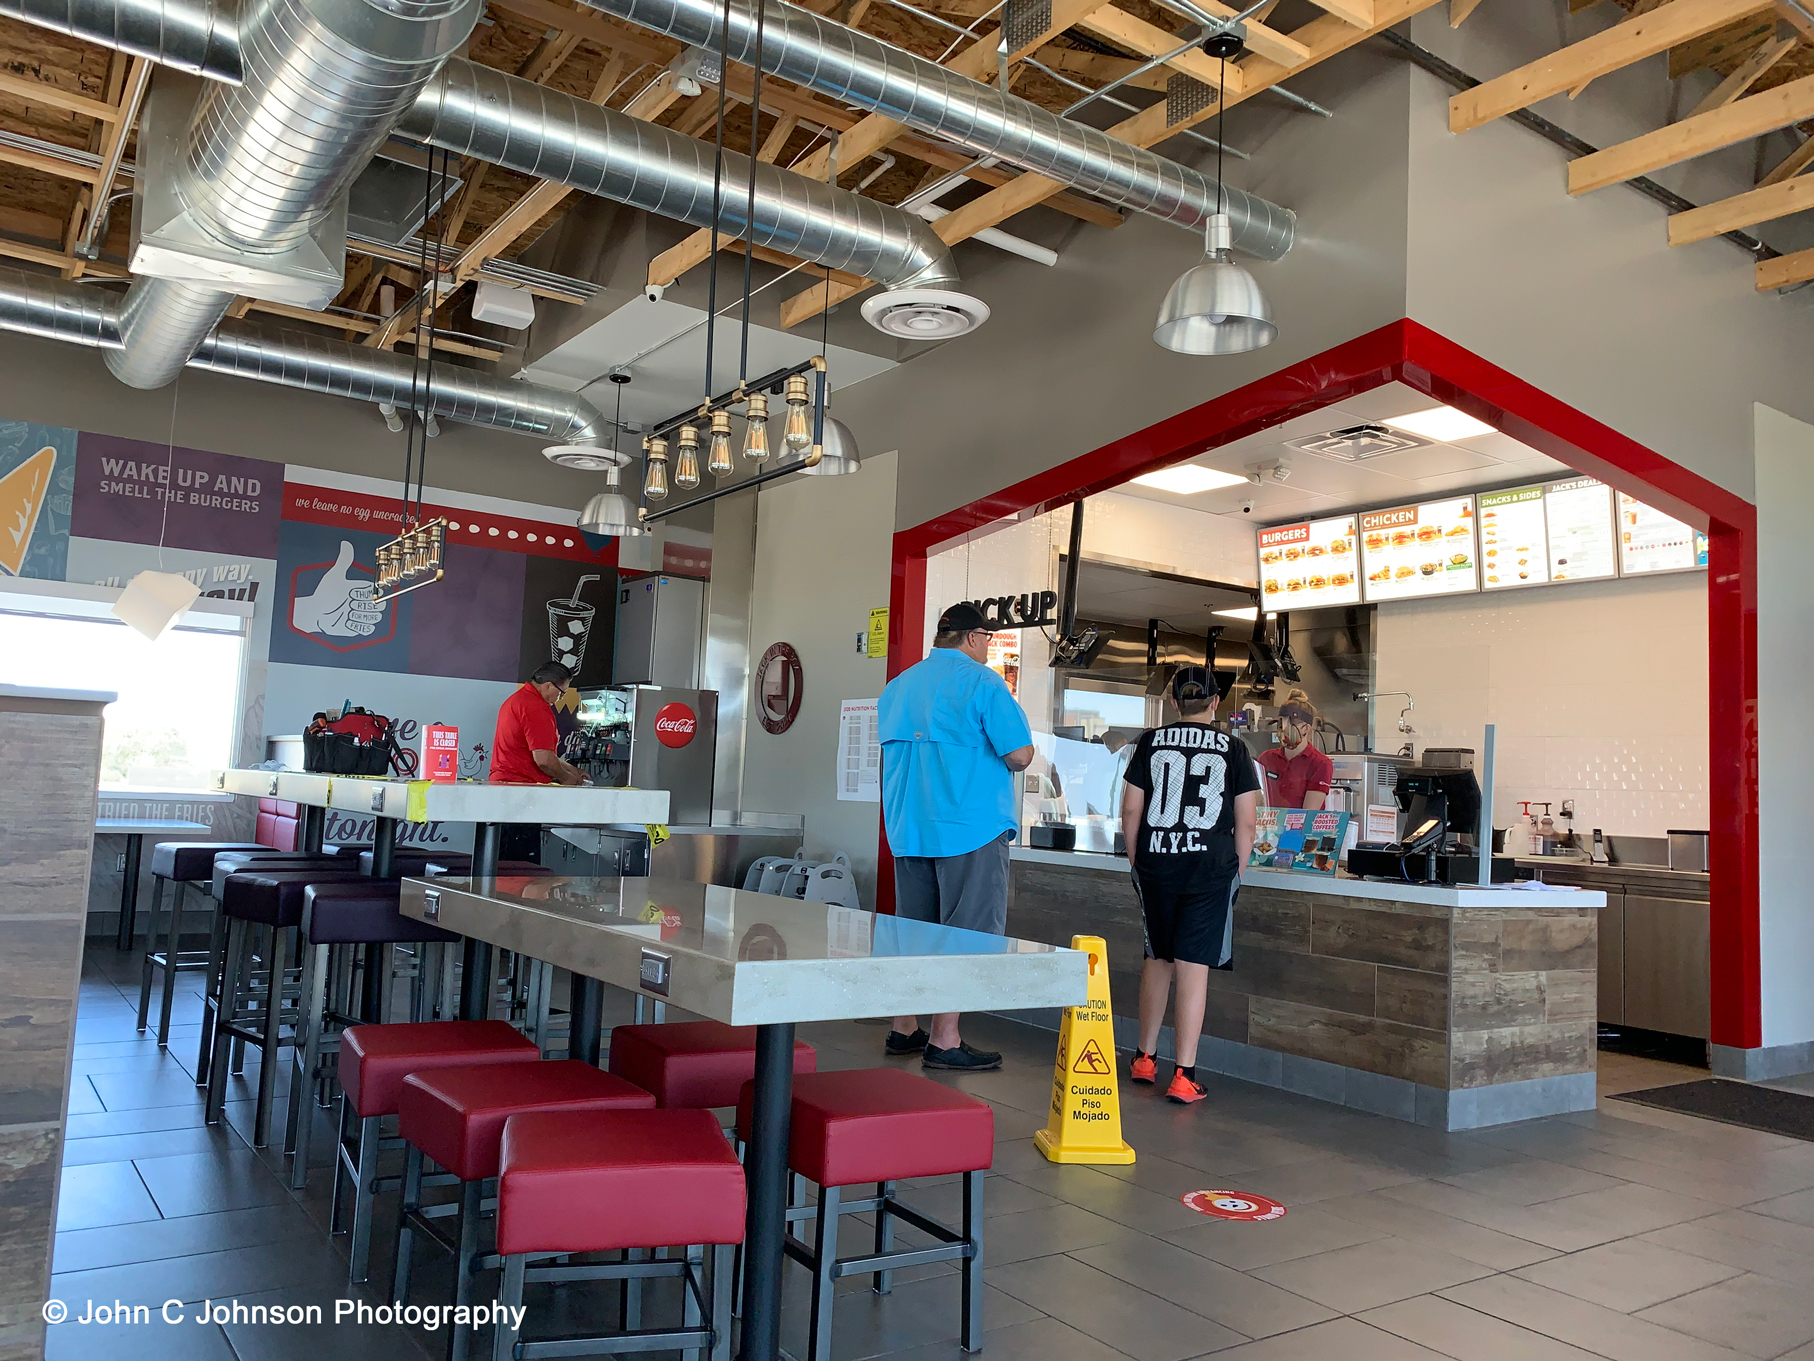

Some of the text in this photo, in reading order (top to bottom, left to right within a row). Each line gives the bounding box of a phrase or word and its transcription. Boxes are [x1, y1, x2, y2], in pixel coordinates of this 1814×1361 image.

[101, 457, 261, 497] WAKE UP AND
[1552, 481, 1577, 493] JACK'S
[100, 480, 260, 513] SMELL THE BURGERS
[1482, 490, 1541, 507] SNACKS & SIDES
[295, 498, 310, 508] we
[312, 498, 338, 512] leave
[340, 505, 352, 515] no
[354, 507, 370, 521] egg
[1363, 510, 1414, 528] CHICKEN
[1261, 528, 1307, 544] BURGERS
[213, 563, 253, 583] way.
[357, 602, 378, 610] RISE
[1021, 591, 1057, 621] UP
[352, 612, 362, 620] FOR
[350, 622, 371, 633] FRIES
[1000, 640, 1018, 648] COMBO
[656, 717, 696, 733] Coca-Cola
[1152, 727, 1230, 753] ADIDAS
[1147, 749, 1227, 829] 03
[144, 803, 169, 819] THE
[175, 804, 215, 825] FRIES
[1256, 818, 1276, 827] ACOS
[1149, 831, 1207, 853] N.Y.C.
[1079, 1000, 1107, 1009] UTION
[1076, 1011, 1089, 1021] Wet
[1091, 1011, 1109, 1022] Floor
[1071, 1085, 1112, 1096] Cuidado
[1082, 1099, 1101, 1109] Piso
[1073, 1110, 1110, 1123] Mojado
